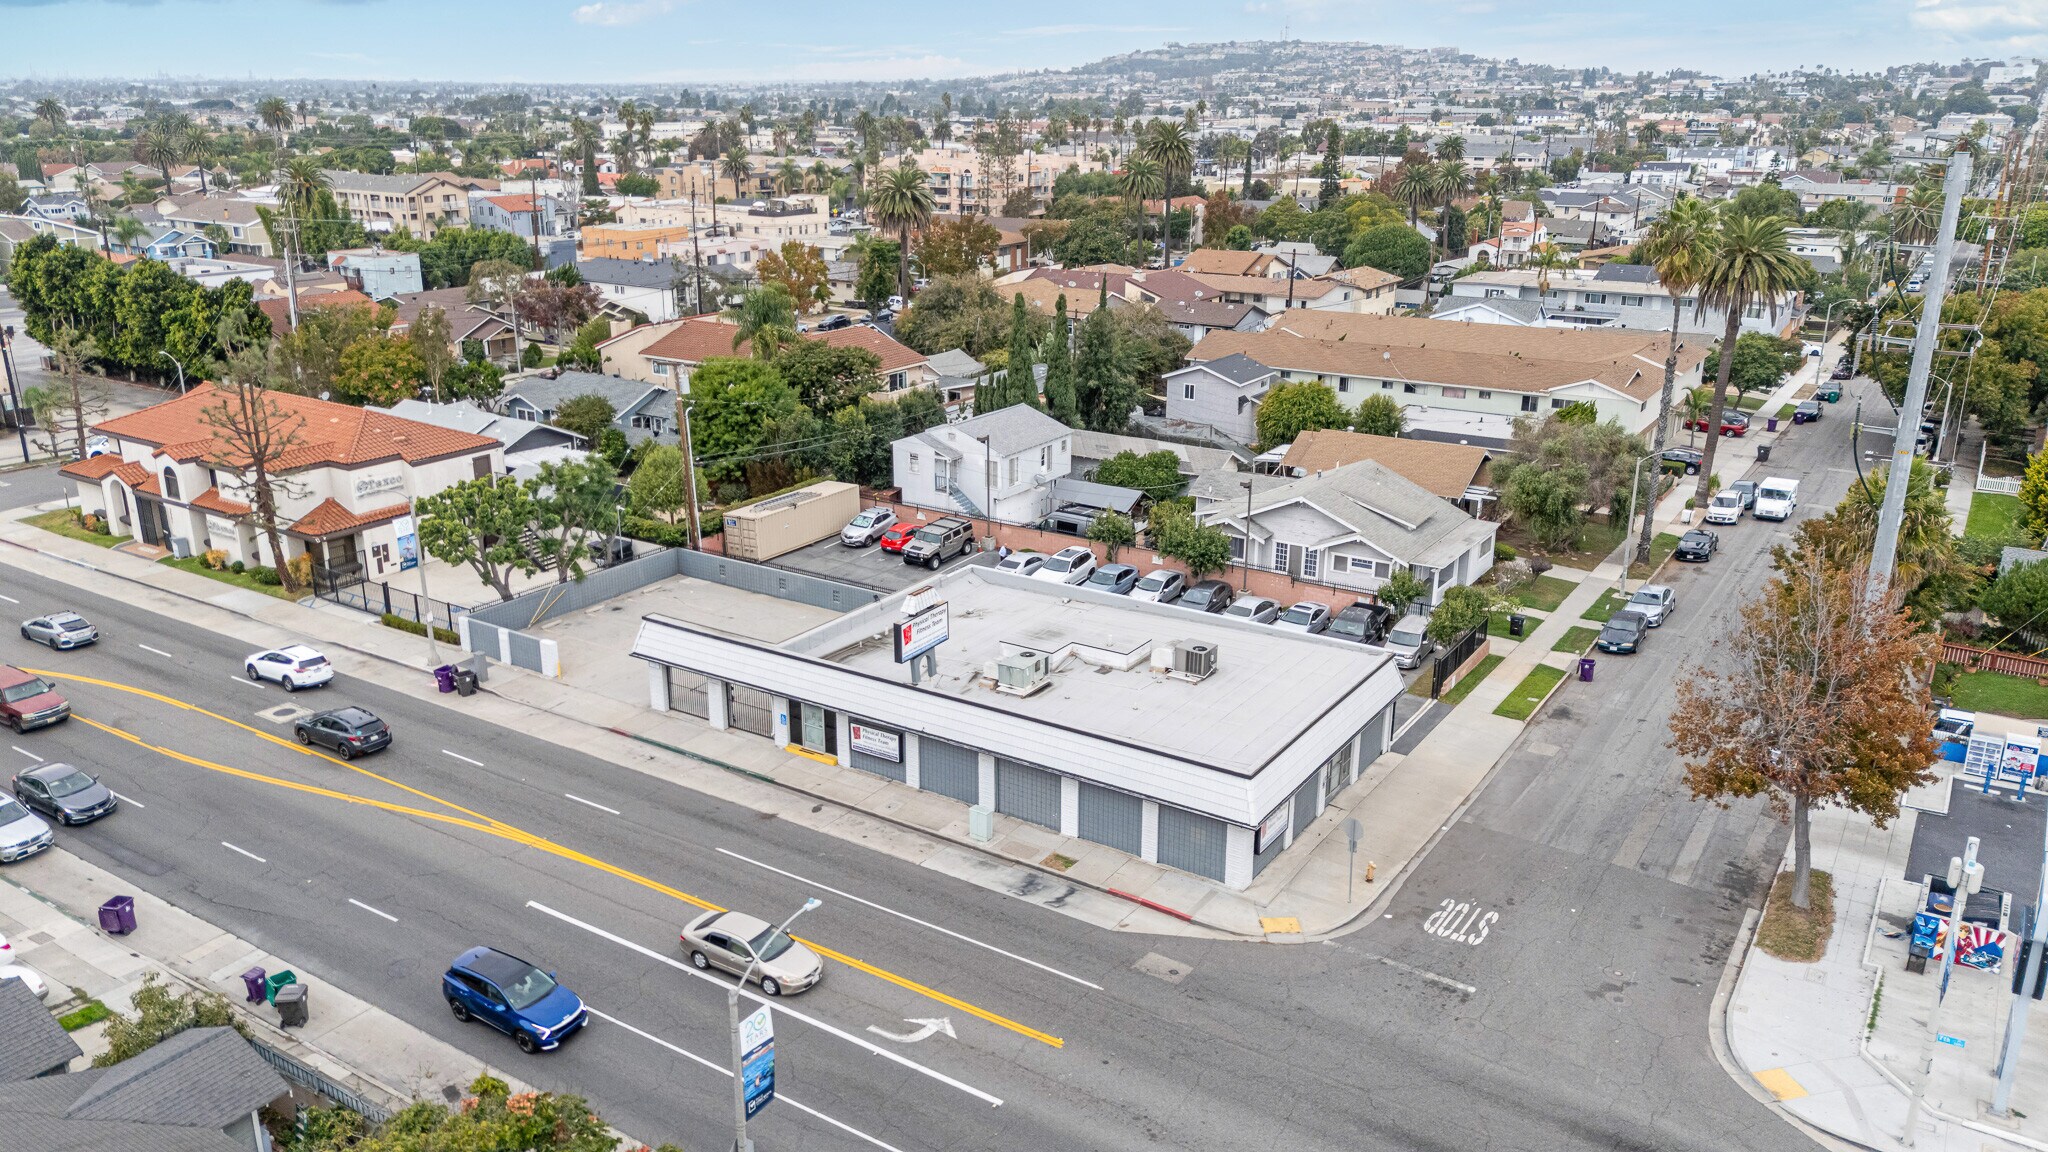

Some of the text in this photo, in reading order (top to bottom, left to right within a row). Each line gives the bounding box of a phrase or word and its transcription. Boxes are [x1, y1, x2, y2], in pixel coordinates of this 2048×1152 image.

[912, 608, 947, 628] Physical Therapy
[916, 618, 943, 634] Fitness Team
[862, 727, 897, 743] Physical Therapy
[862, 734, 877, 742] Fitness
[877, 738, 889, 746] Team
[1423, 898, 1499, 946] STOP
